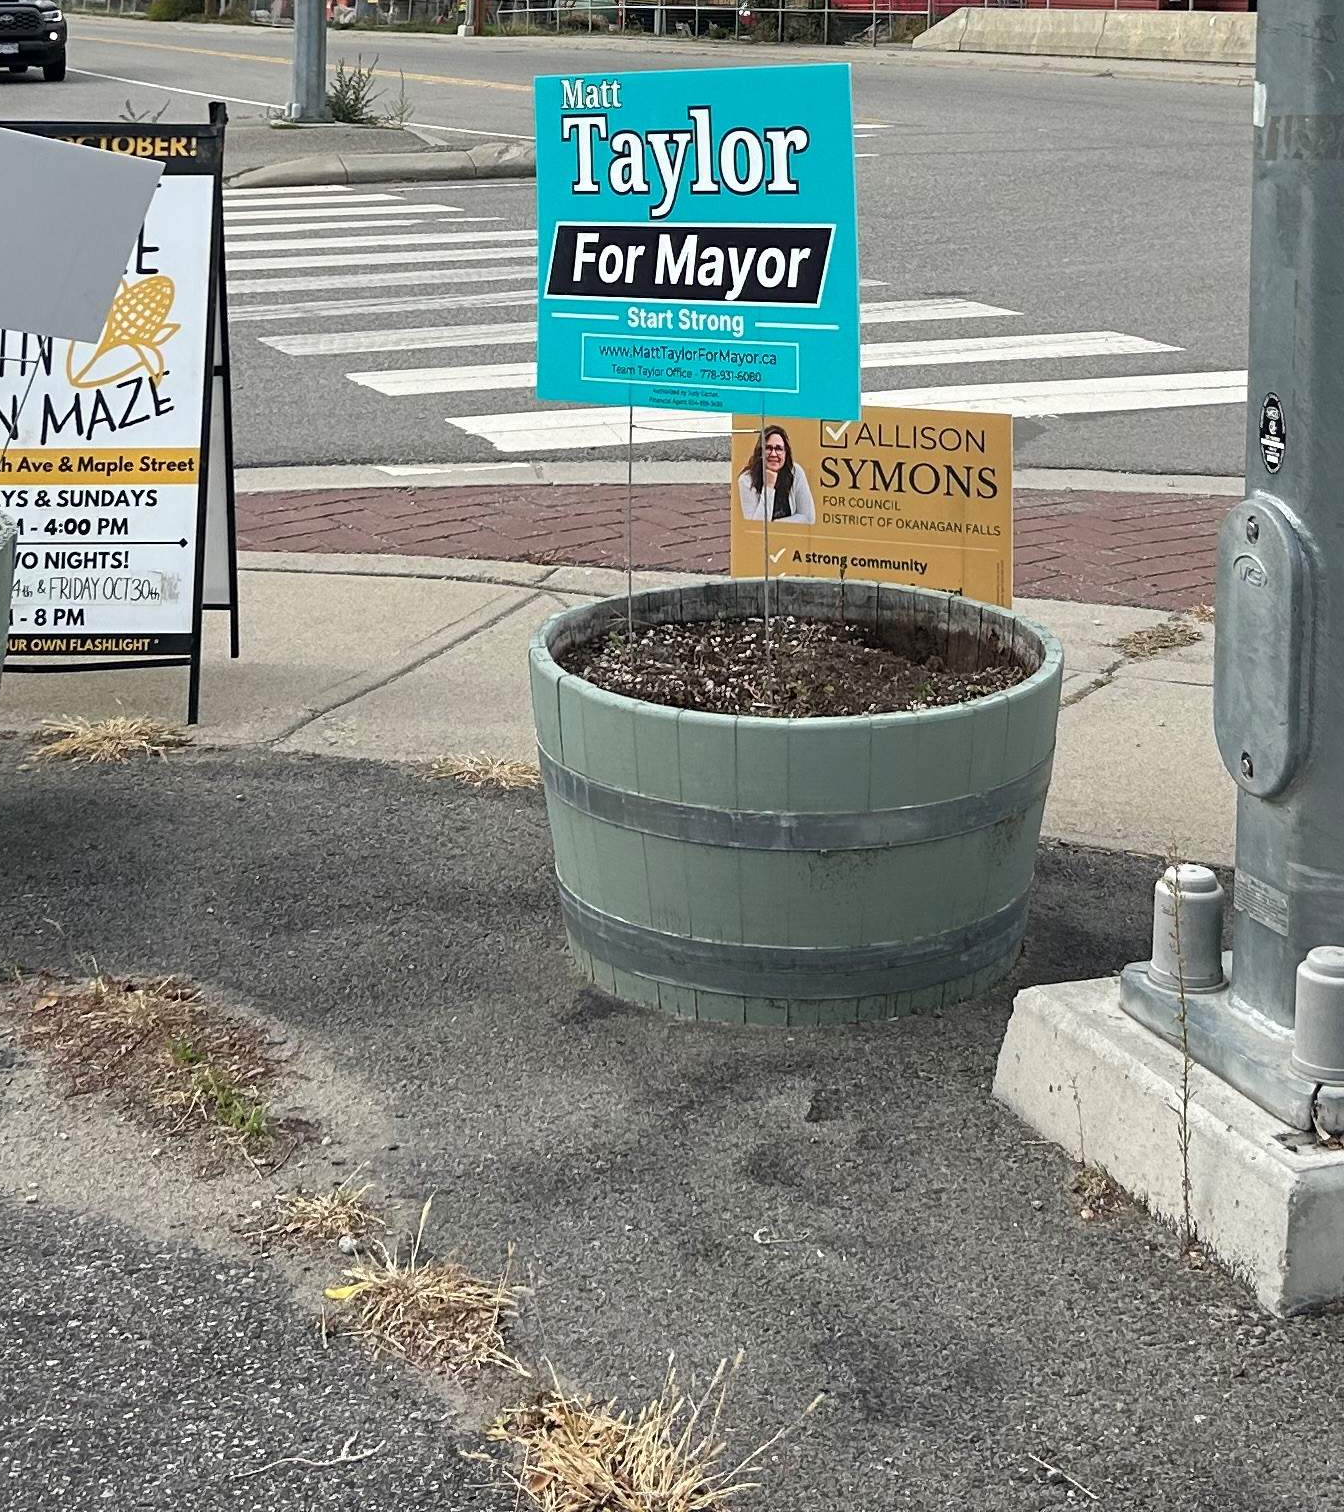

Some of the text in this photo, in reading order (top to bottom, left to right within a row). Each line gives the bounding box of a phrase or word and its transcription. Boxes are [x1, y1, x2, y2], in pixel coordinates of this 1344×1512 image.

[560, 78, 622, 109] Matt
[56, 136, 198, 157] TOBER!
[560, 104, 810, 220] Taylor
[572, 231, 811, 301] For Mayor
[627, 306, 744, 337] Start Strong
[599, 345, 777, 366] www.MattTaylorForMayor.ca
[612, 363, 636, 376] Team
[666, 367, 692, 379] Office
[40, 370, 175, 445] MAZE
[854, 422, 986, 454] ALLISON
[17, 457, 54, 473] Ave
[58, 457, 73, 473] &
[77, 456, 134, 476] Maple
[139, 455, 195, 473] Street
[819, 456, 999, 499] SYMONS
[35, 490, 51, 507] &
[57, 490, 158, 508] SUNDAYS
[822, 495, 901, 511] FOR COUNCIL
[44, 518, 91, 536] 4:00
[97, 518, 129, 535] PM
[822, 513, 1001, 536] DISTRICT OF OKANAGAN FALLS
[44, 551, 130, 569] NIGHTS!
[792, 550, 928, 575] A strong community
[49, 576, 100, 601] FRIDAY
[34, 609, 47, 626] 8
[53, 609, 85, 626] PM
[6, 638, 151, 652] UR OWN FLASHLIGHT
